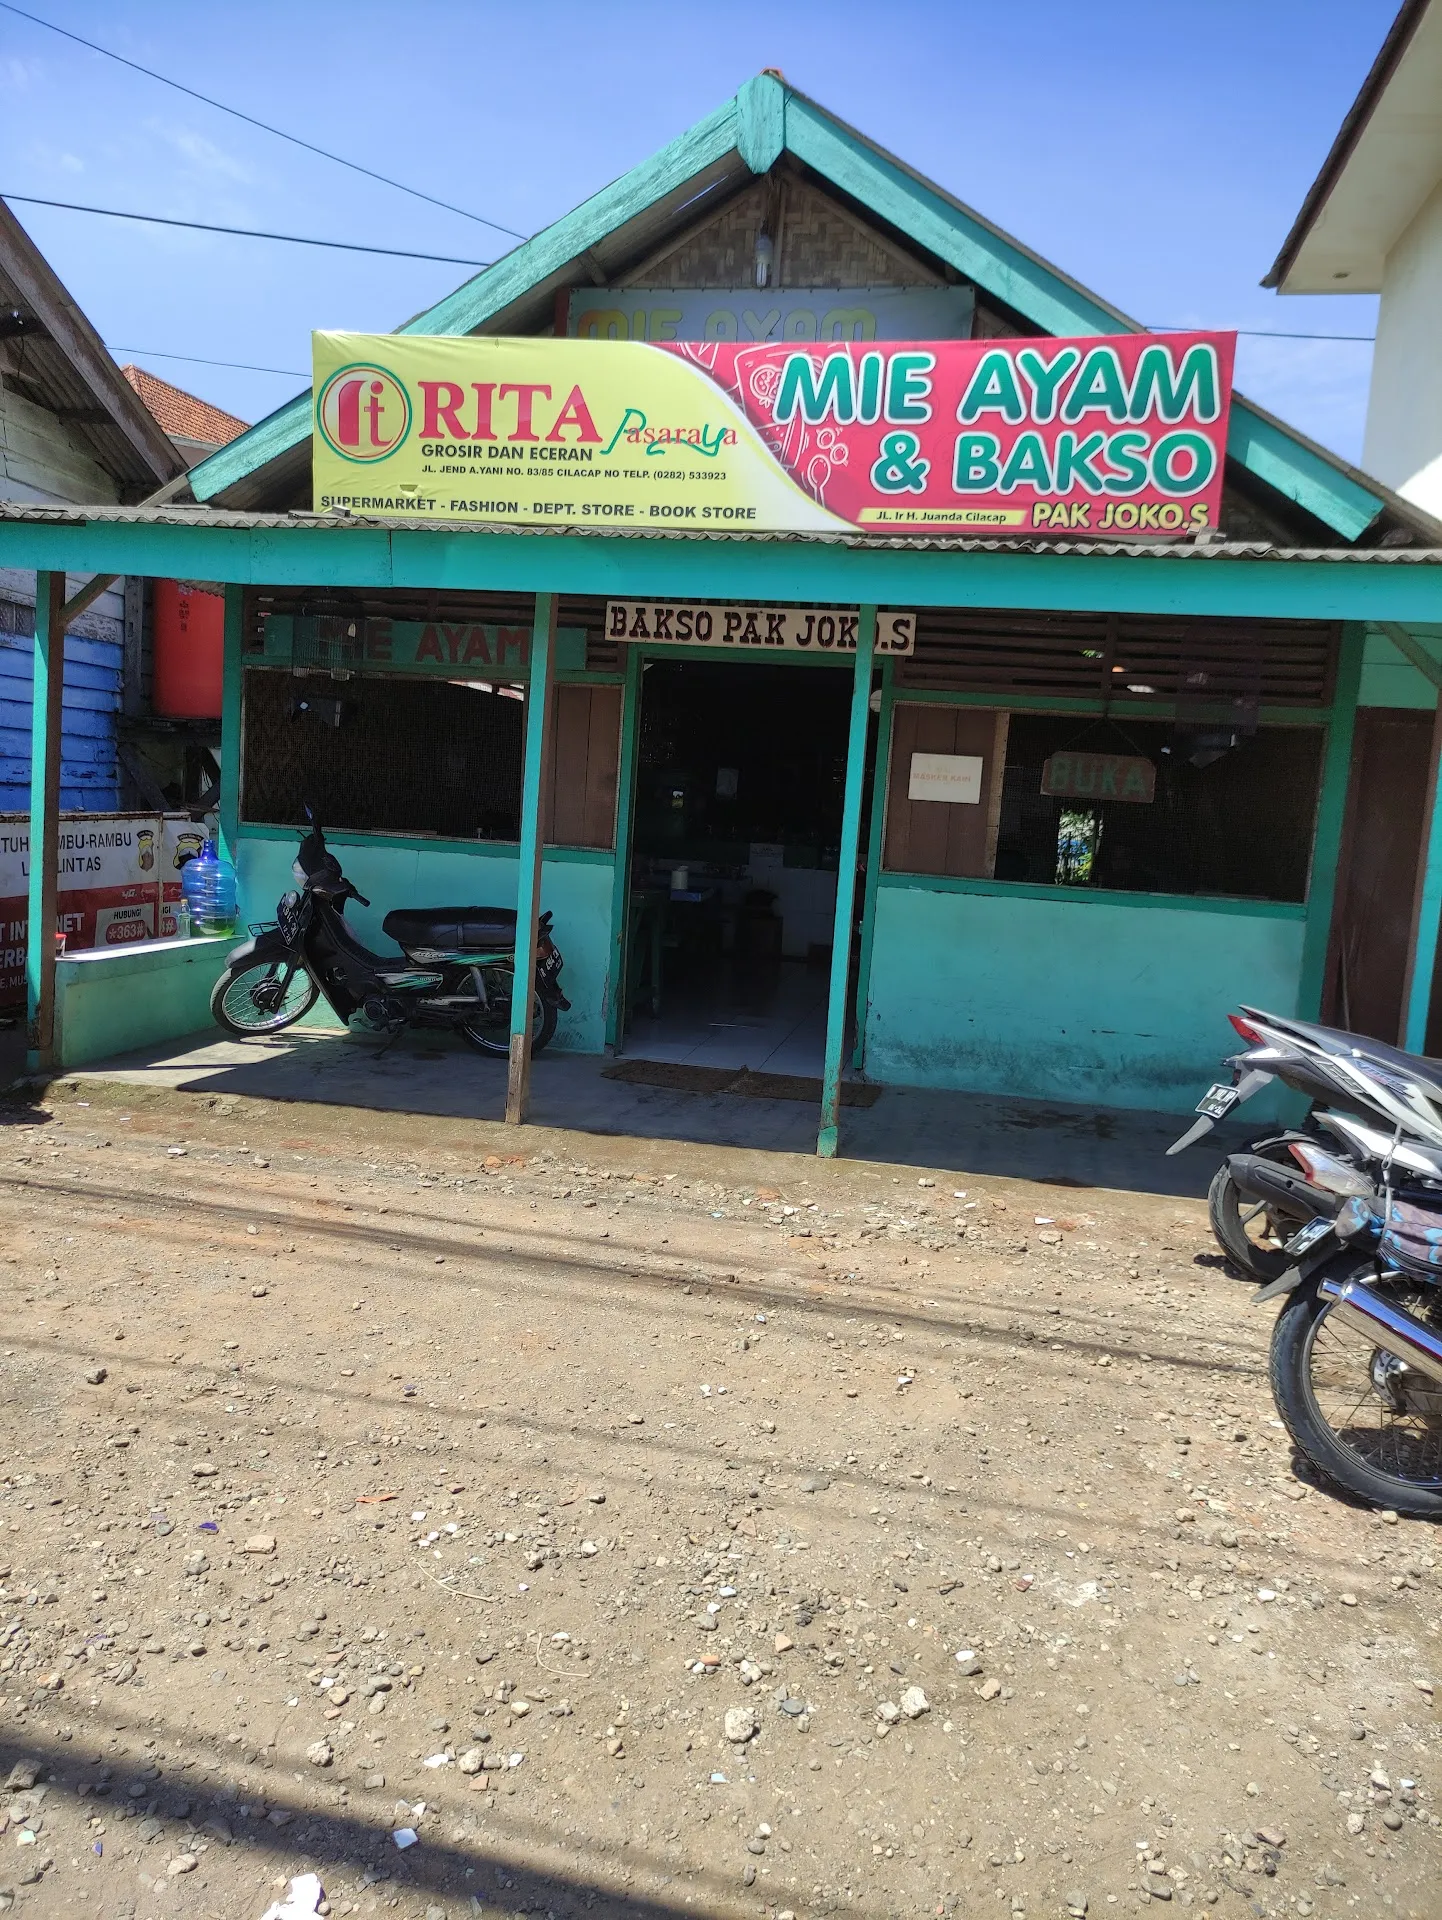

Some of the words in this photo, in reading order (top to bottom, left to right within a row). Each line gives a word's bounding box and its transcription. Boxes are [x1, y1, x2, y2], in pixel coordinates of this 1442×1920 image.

[703, 309, 877, 343] AYAM
[772, 349, 936, 426] MIE
[955, 343, 1221, 426] AYAM
[417, 380, 604, 443] RITA
[598, 408, 738, 457] Pasaraya
[421, 444, 483, 459] GROSIR
[487, 446, 524, 460] DAN
[529, 447, 594, 462] ECERAN
[869, 430, 931, 495] &
[951, 428, 1218, 498] BAKSO
[421, 464, 437, 474] JL.
[439, 465, 466, 475] JEND
[468, 466, 503, 476] A.YANI
[506, 467, 524, 476] NO.
[526, 467, 554, 477] 83/85
[556, 468, 601, 478] CILACAP
[604, 469, 620, 479] NO
[622, 470, 651, 480] TELP.
[653, 470, 686, 482] (0282)
[688, 471, 727, 481] 533923
[320, 495, 437, 511] SUPERMARKET
[450, 500, 519, 514] FASHION
[532, 502, 577, 516] DEPT.
[581, 504, 635, 517] STORE
[649, 506, 698, 519] BOOK
[701, 507, 758, 520] STORE
[876, 511, 892, 520] JL.
[906, 512, 919, 521] H.
[920, 512, 963, 522] Juanda
[965, 512, 1007, 525] Cilacap
[1031, 502, 1091, 529] PAK
[414, 624, 532, 665] AYAM
[609, 606, 713, 642] BAKSO
[723, 611, 787, 646] PAK
[796, 615, 911, 652] JOK.S
[113, 908, 142, 920] HUBUNGI
